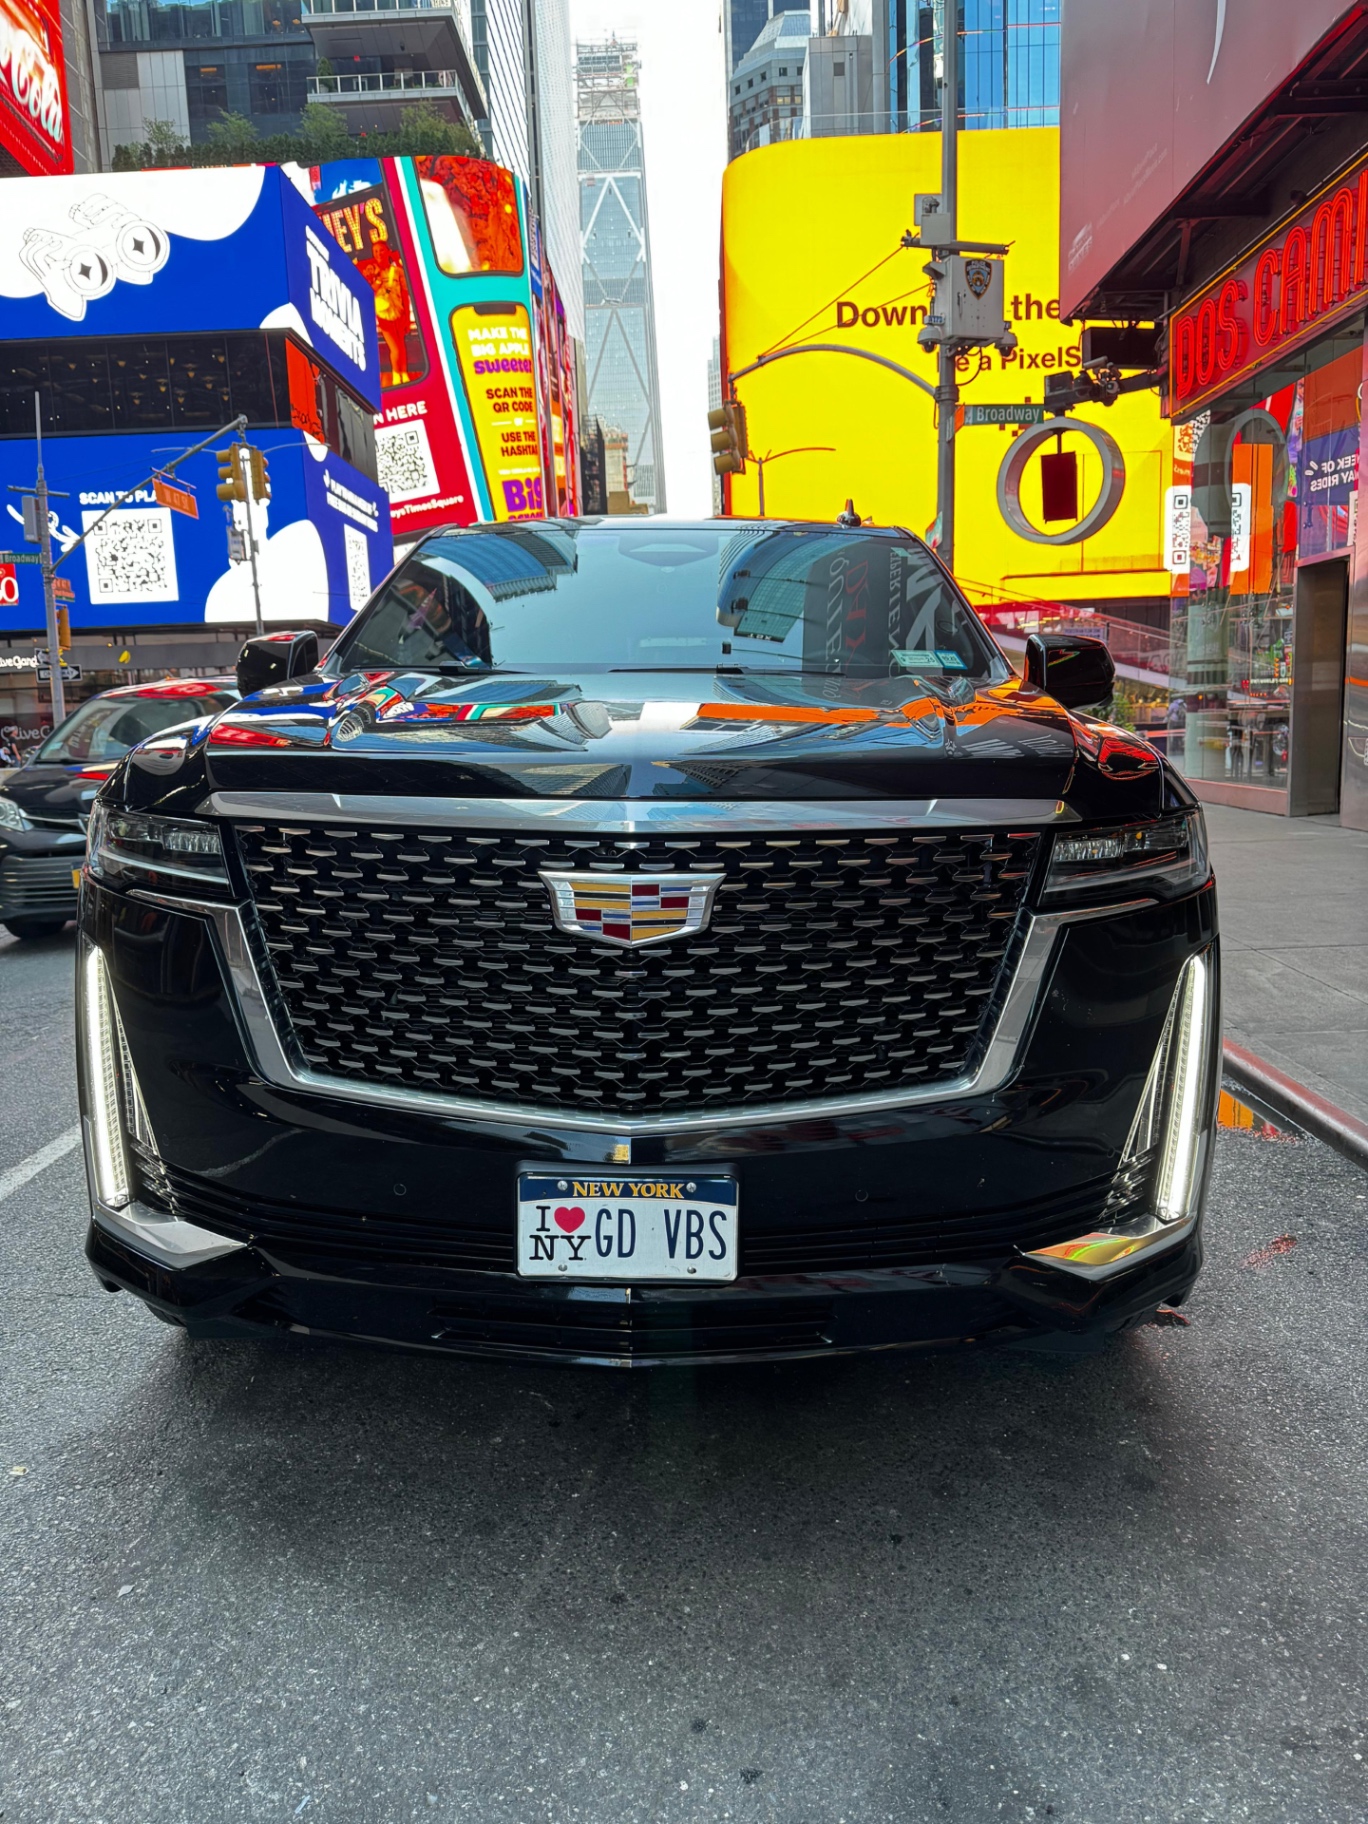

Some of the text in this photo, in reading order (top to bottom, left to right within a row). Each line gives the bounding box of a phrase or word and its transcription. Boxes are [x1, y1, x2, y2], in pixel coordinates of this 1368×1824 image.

[837, 293, 1060, 329] Down the
[468, 327, 527, 341] MAKE THE
[1176, 279, 1240, 400] DOS
[471, 343, 496, 357] BIG
[486, 387, 533, 400] SCAN THE
[386, 401, 428, 421] HERE
[493, 401, 533, 413] QR CODE
[976, 406, 1040, 424] Broadway
[501, 431, 536, 443] USE THE
[79, 491, 116, 505] SCAN
[5, 554, 39, 564] Broadway
[573, 1181, 685, 1199] NEW YORK
[536, 1206, 551, 1231] I
[595, 1208, 727, 1260] GD VBS
[529, 1235, 592, 1260] NY
